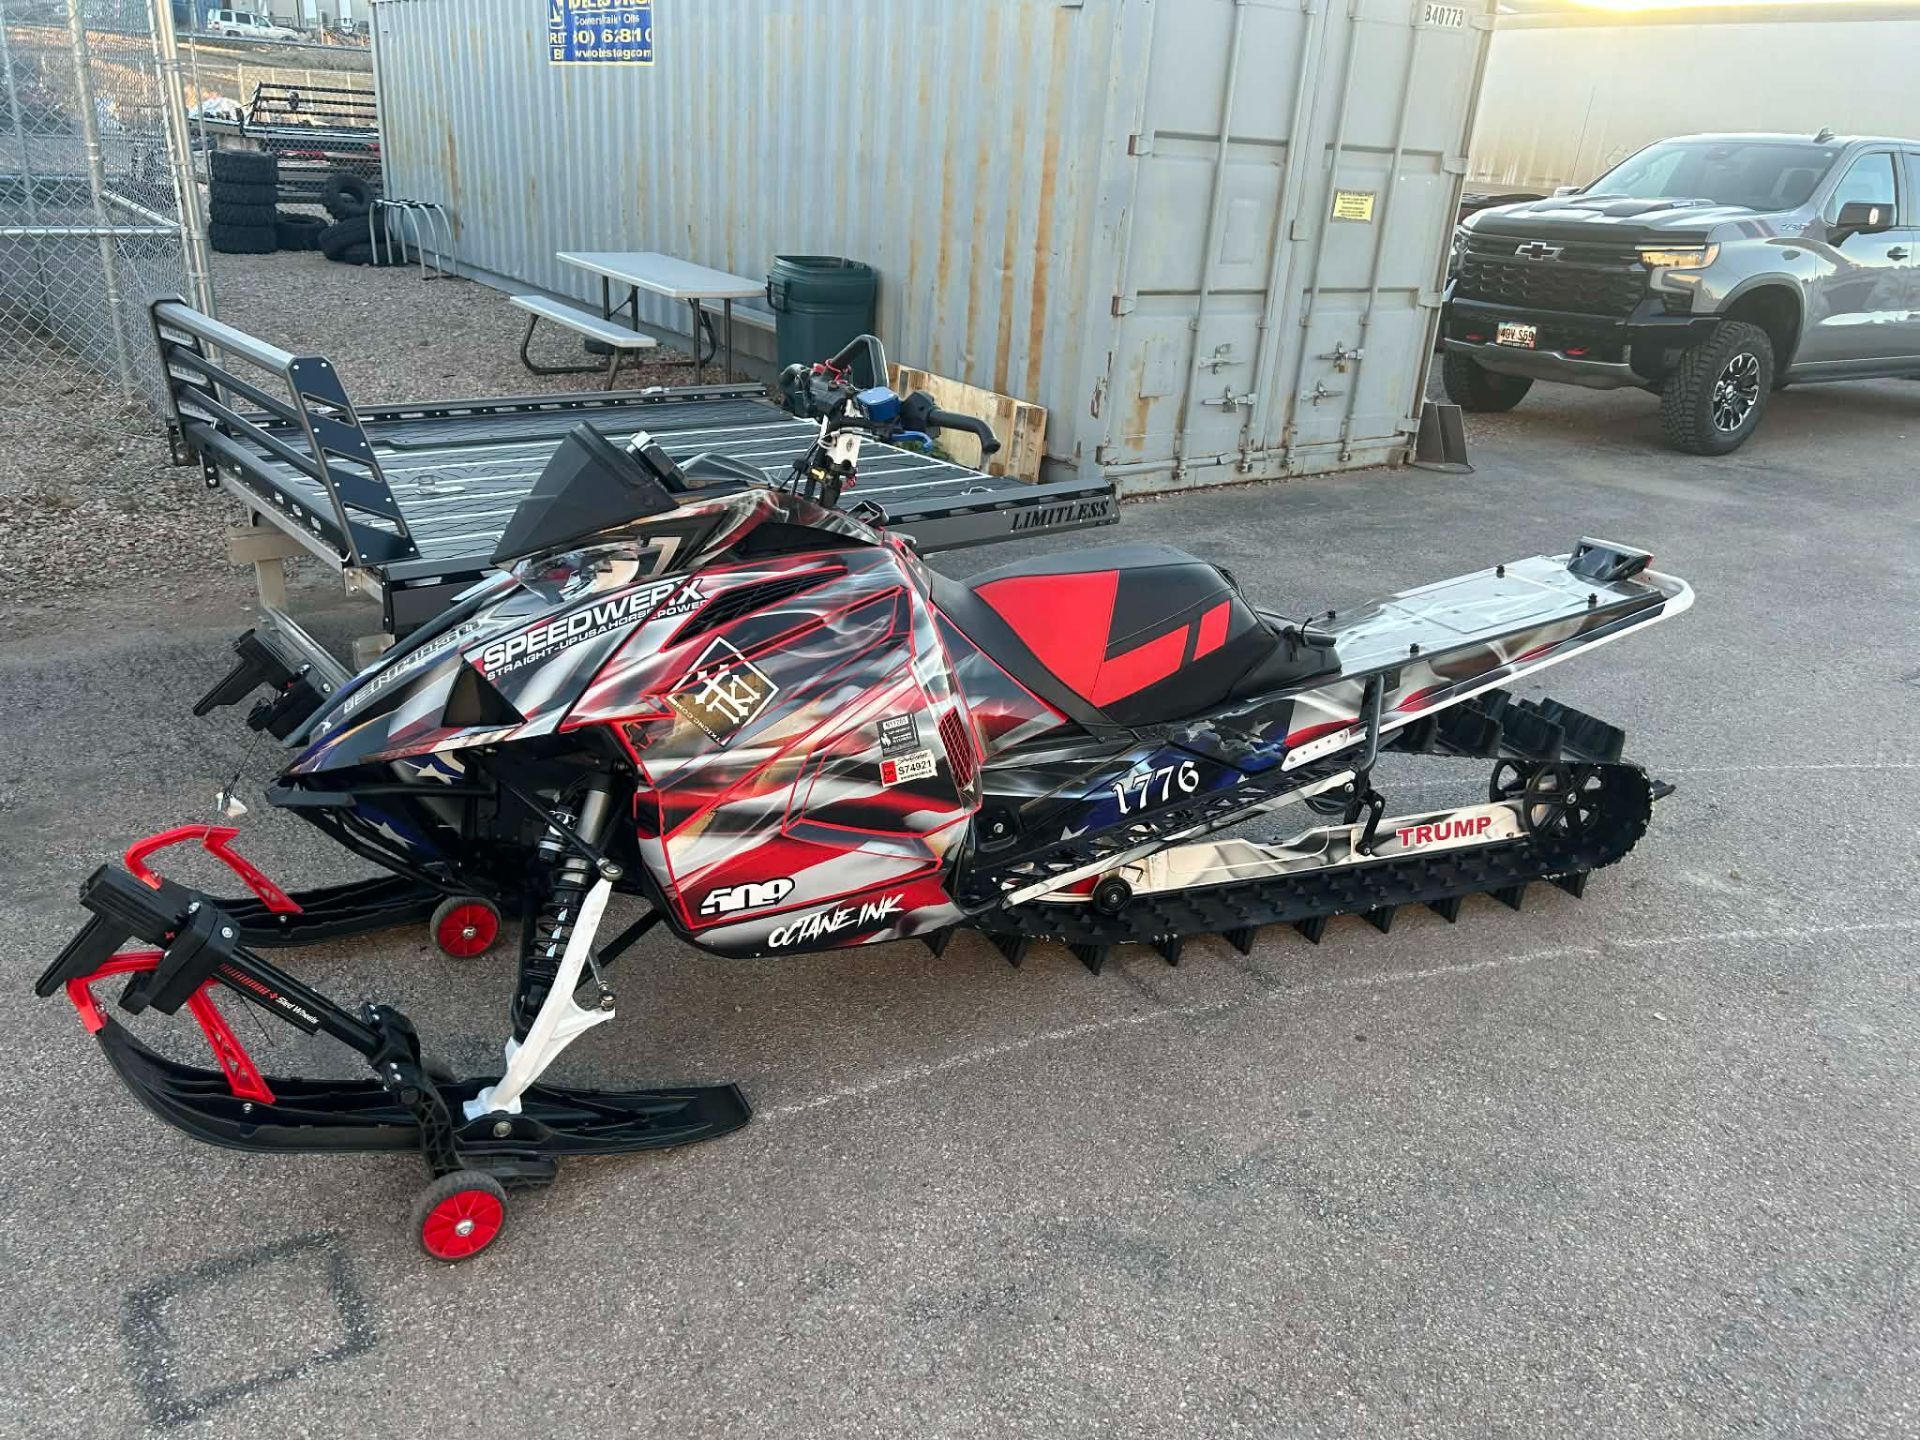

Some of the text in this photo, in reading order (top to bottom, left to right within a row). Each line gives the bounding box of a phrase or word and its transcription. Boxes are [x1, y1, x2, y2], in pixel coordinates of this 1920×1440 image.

[1010, 500, 1109, 531] LIMITLESS
[484, 578, 709, 671] SPEEDWERX
[487, 636, 578, 681] STRAIGHT-UP
[578, 625, 607, 644] USA
[1111, 760, 1200, 815] 1776
[1397, 816, 1492, 847] TRUMP
[700, 878, 795, 916] 509
[768, 893, 905, 948] OCTANE INK
